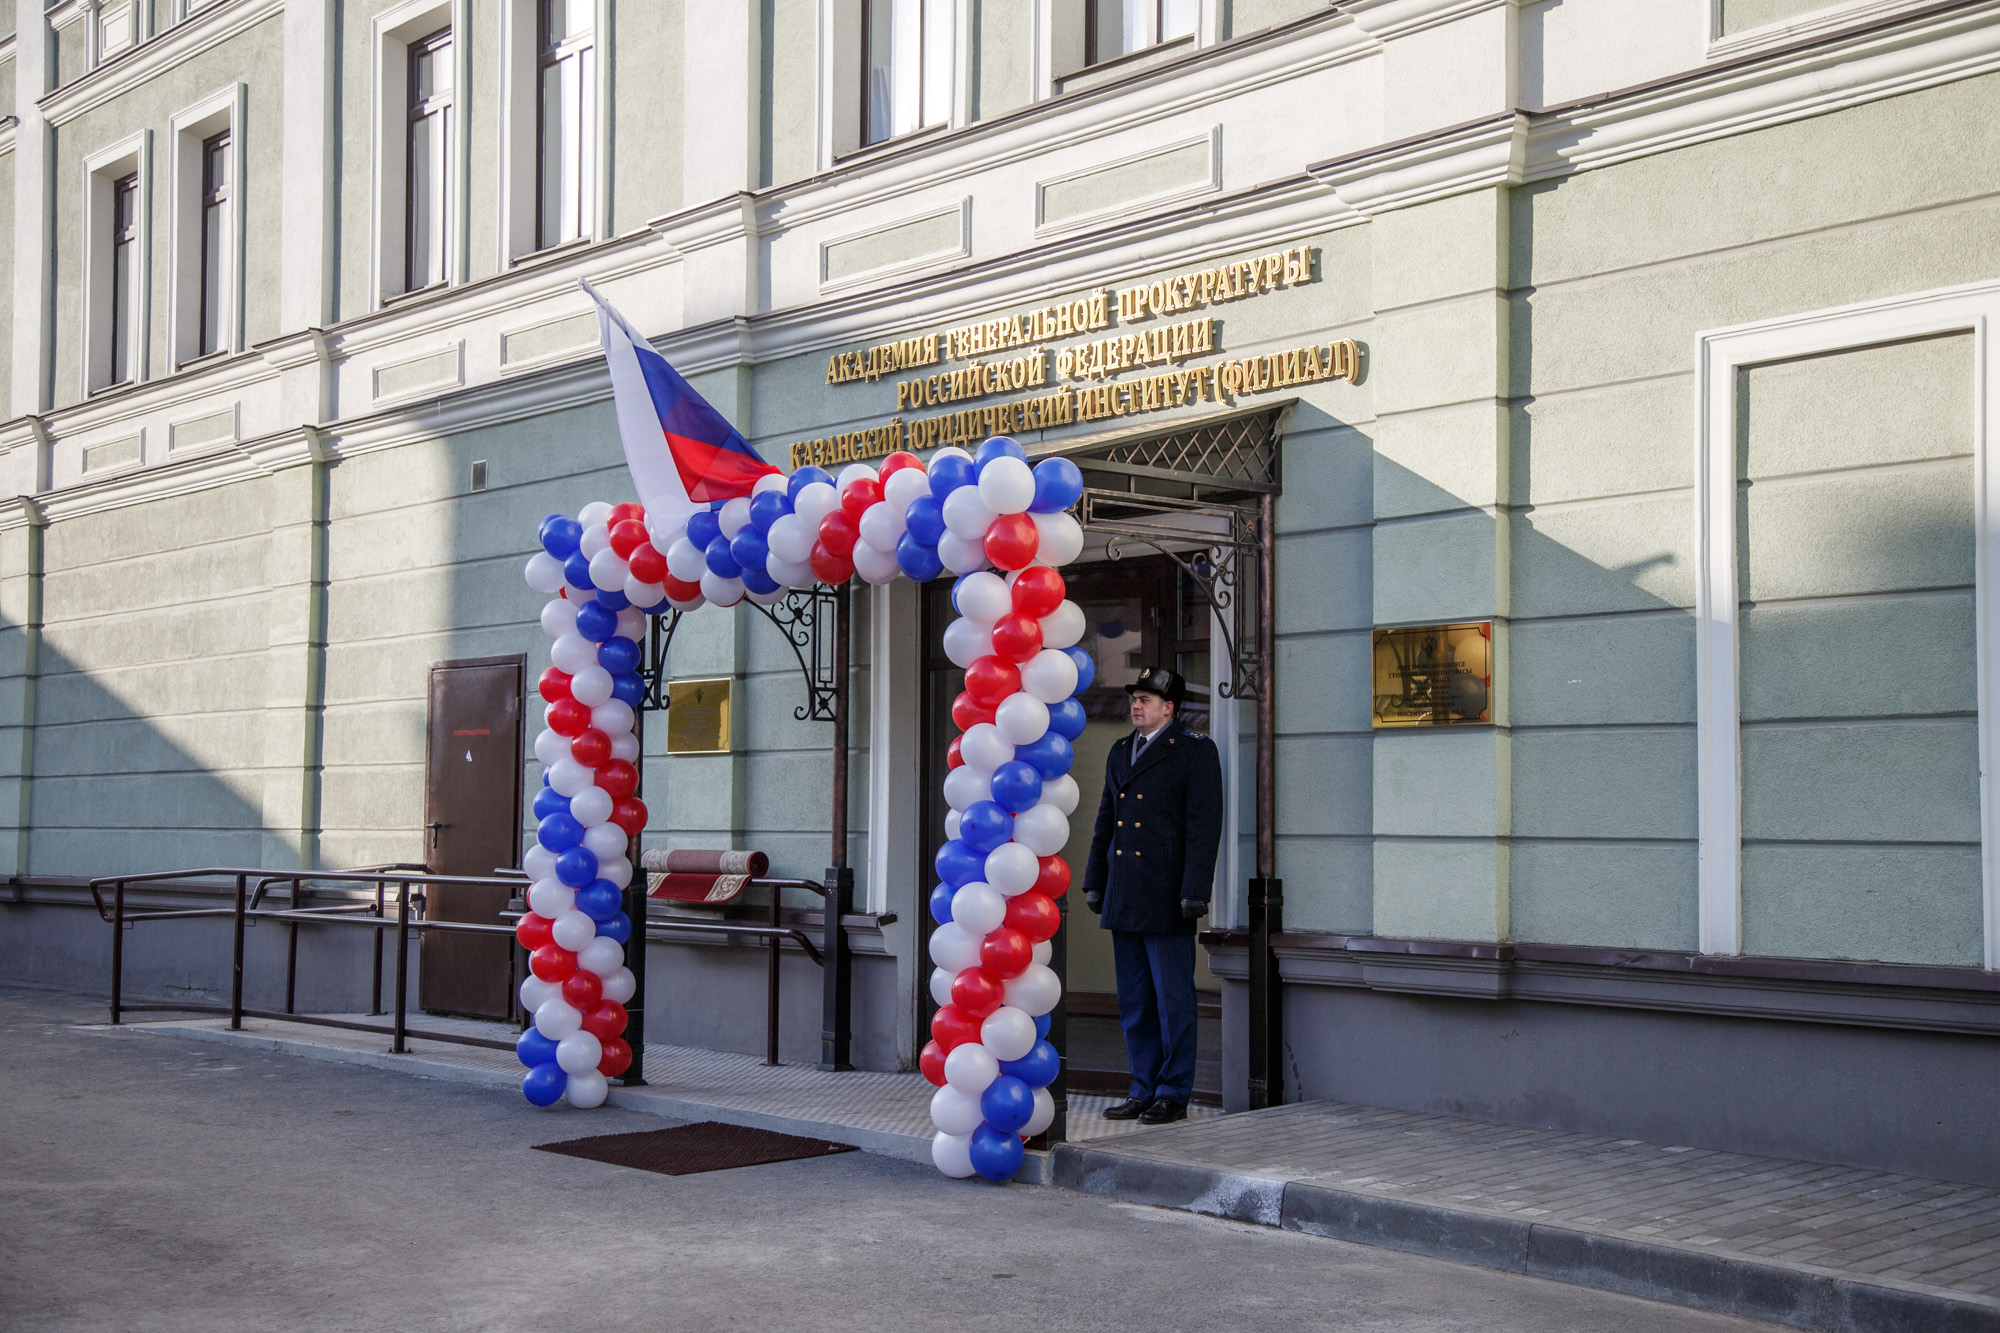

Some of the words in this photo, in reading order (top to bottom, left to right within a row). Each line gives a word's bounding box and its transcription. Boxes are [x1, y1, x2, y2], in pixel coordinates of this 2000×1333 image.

[825, 332, 940, 384] АКАДЕМИЯ
[945, 286, 1109, 360] ГЕНЕРАЛЬНОЙ
[1117, 245, 1312, 322] ПРОКУРАТУРЫ
[897, 346, 1047, 410] РОССИЙСКОЙ
[1056, 317, 1214, 380] ФЕДЕРАЦИИ
[789, 416, 904, 471] КАЗАНСКИЙ
[908, 385, 1075, 447] ЮРИДИЧЕСКИЙ
[1076, 365, 1211, 421] ИНСТИТУТ
[1213, 338, 1360, 405] (ФИЛИАЛ)
